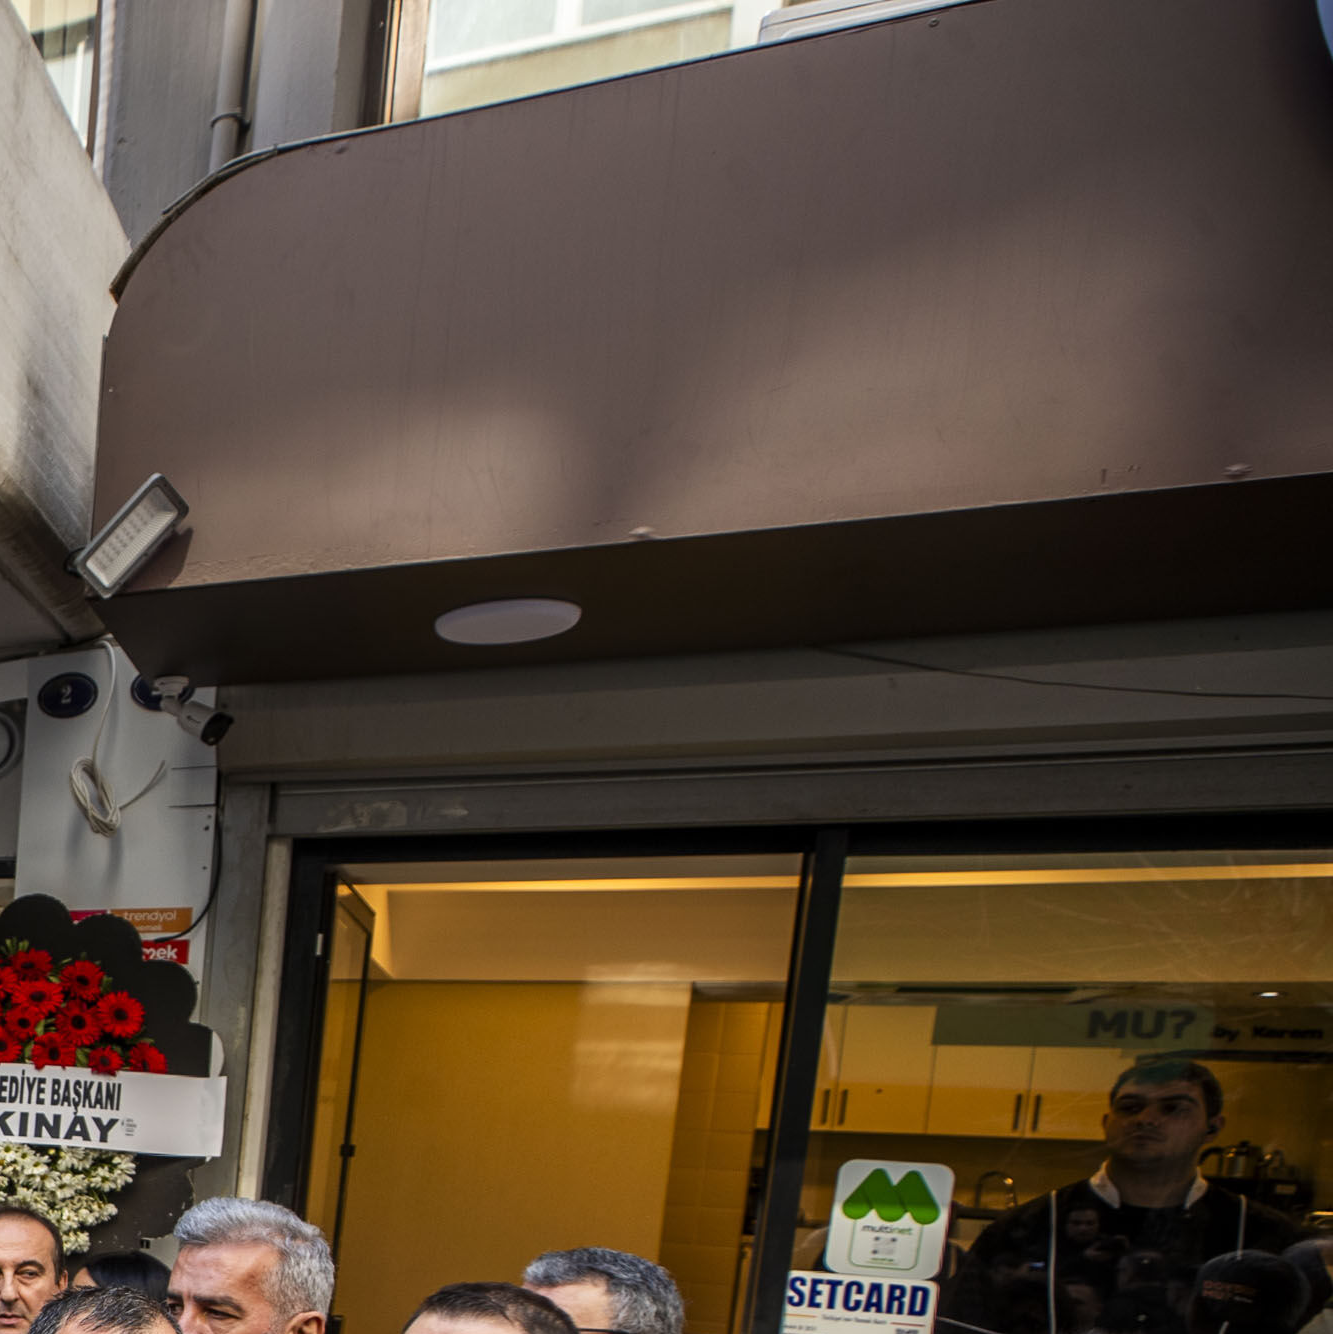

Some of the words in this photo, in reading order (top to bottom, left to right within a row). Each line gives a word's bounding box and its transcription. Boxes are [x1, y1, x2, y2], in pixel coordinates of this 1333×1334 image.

[61, 684, 72, 704] 2
[124, 910, 177, 921] trendyol
[1087, 1009, 1198, 1040] MU?
[1213, 1025, 1240, 1042] by
[50, 1077, 122, 1114] BAŞKANI
[861, 1223, 914, 1236] multinet
[787, 1275, 931, 1317] SETCARD
